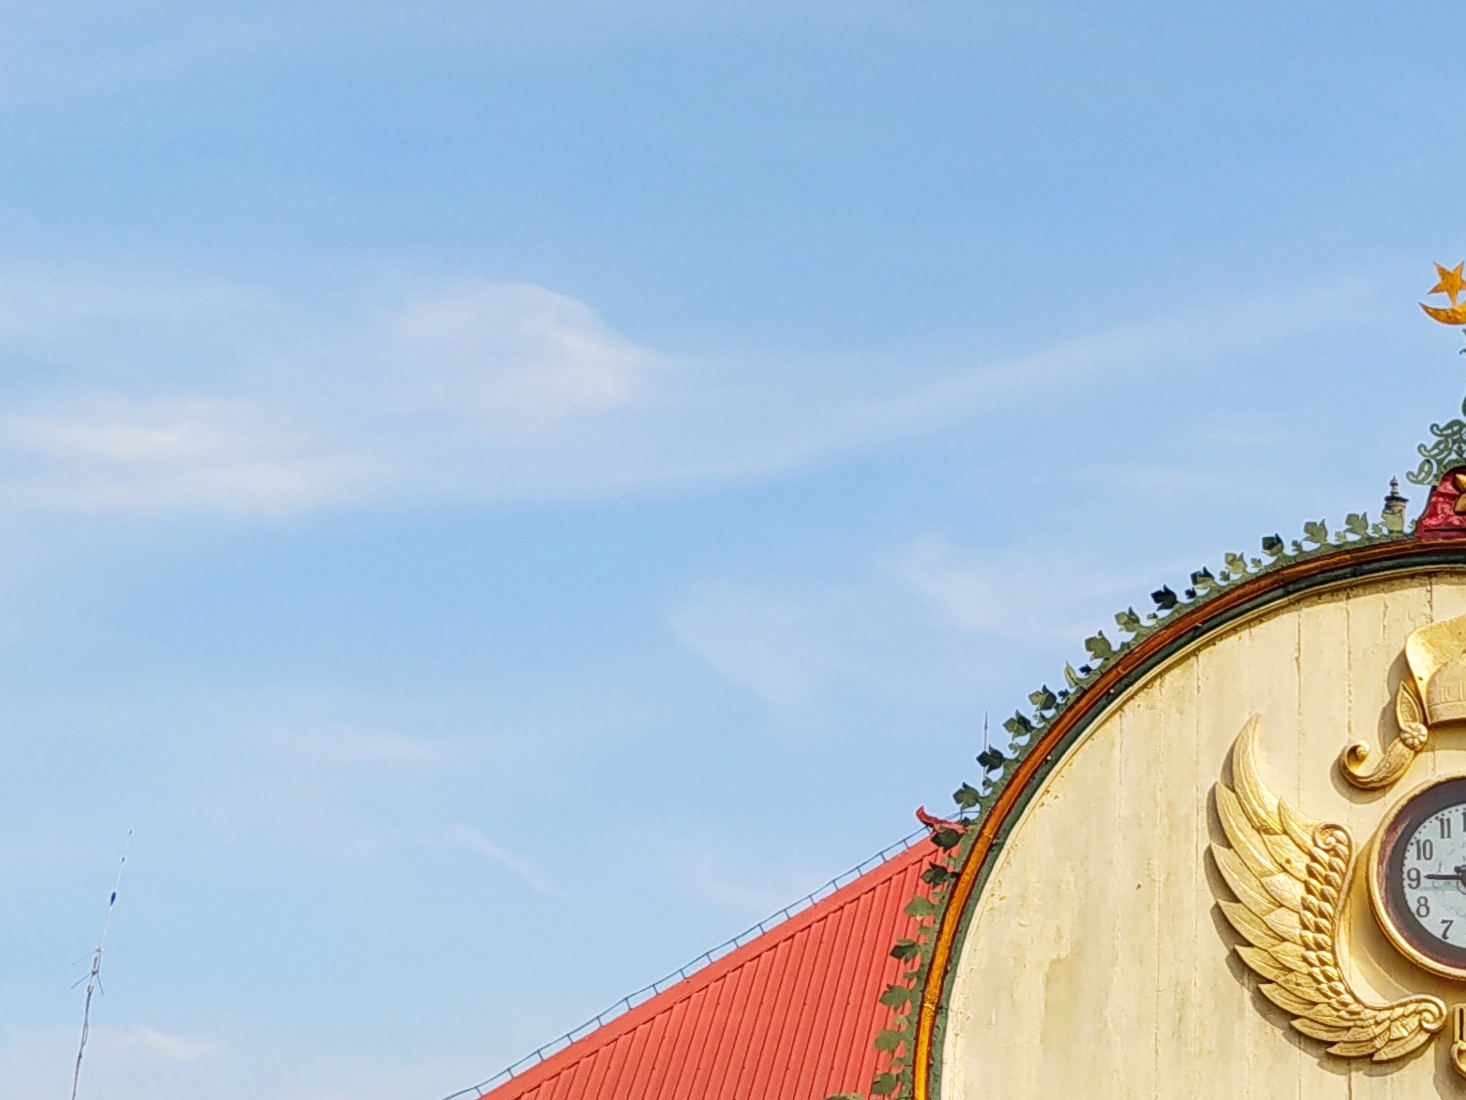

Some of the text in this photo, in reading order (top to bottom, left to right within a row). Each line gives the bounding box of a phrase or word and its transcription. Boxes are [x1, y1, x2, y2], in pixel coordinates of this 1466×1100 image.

[1437, 817, 1453, 839] 11
[1415, 838, 1434, 861] 10
[1406, 867, 1421, 890] 9
[1415, 896, 1430, 918] 8
[1440, 918, 1454, 940] 7
